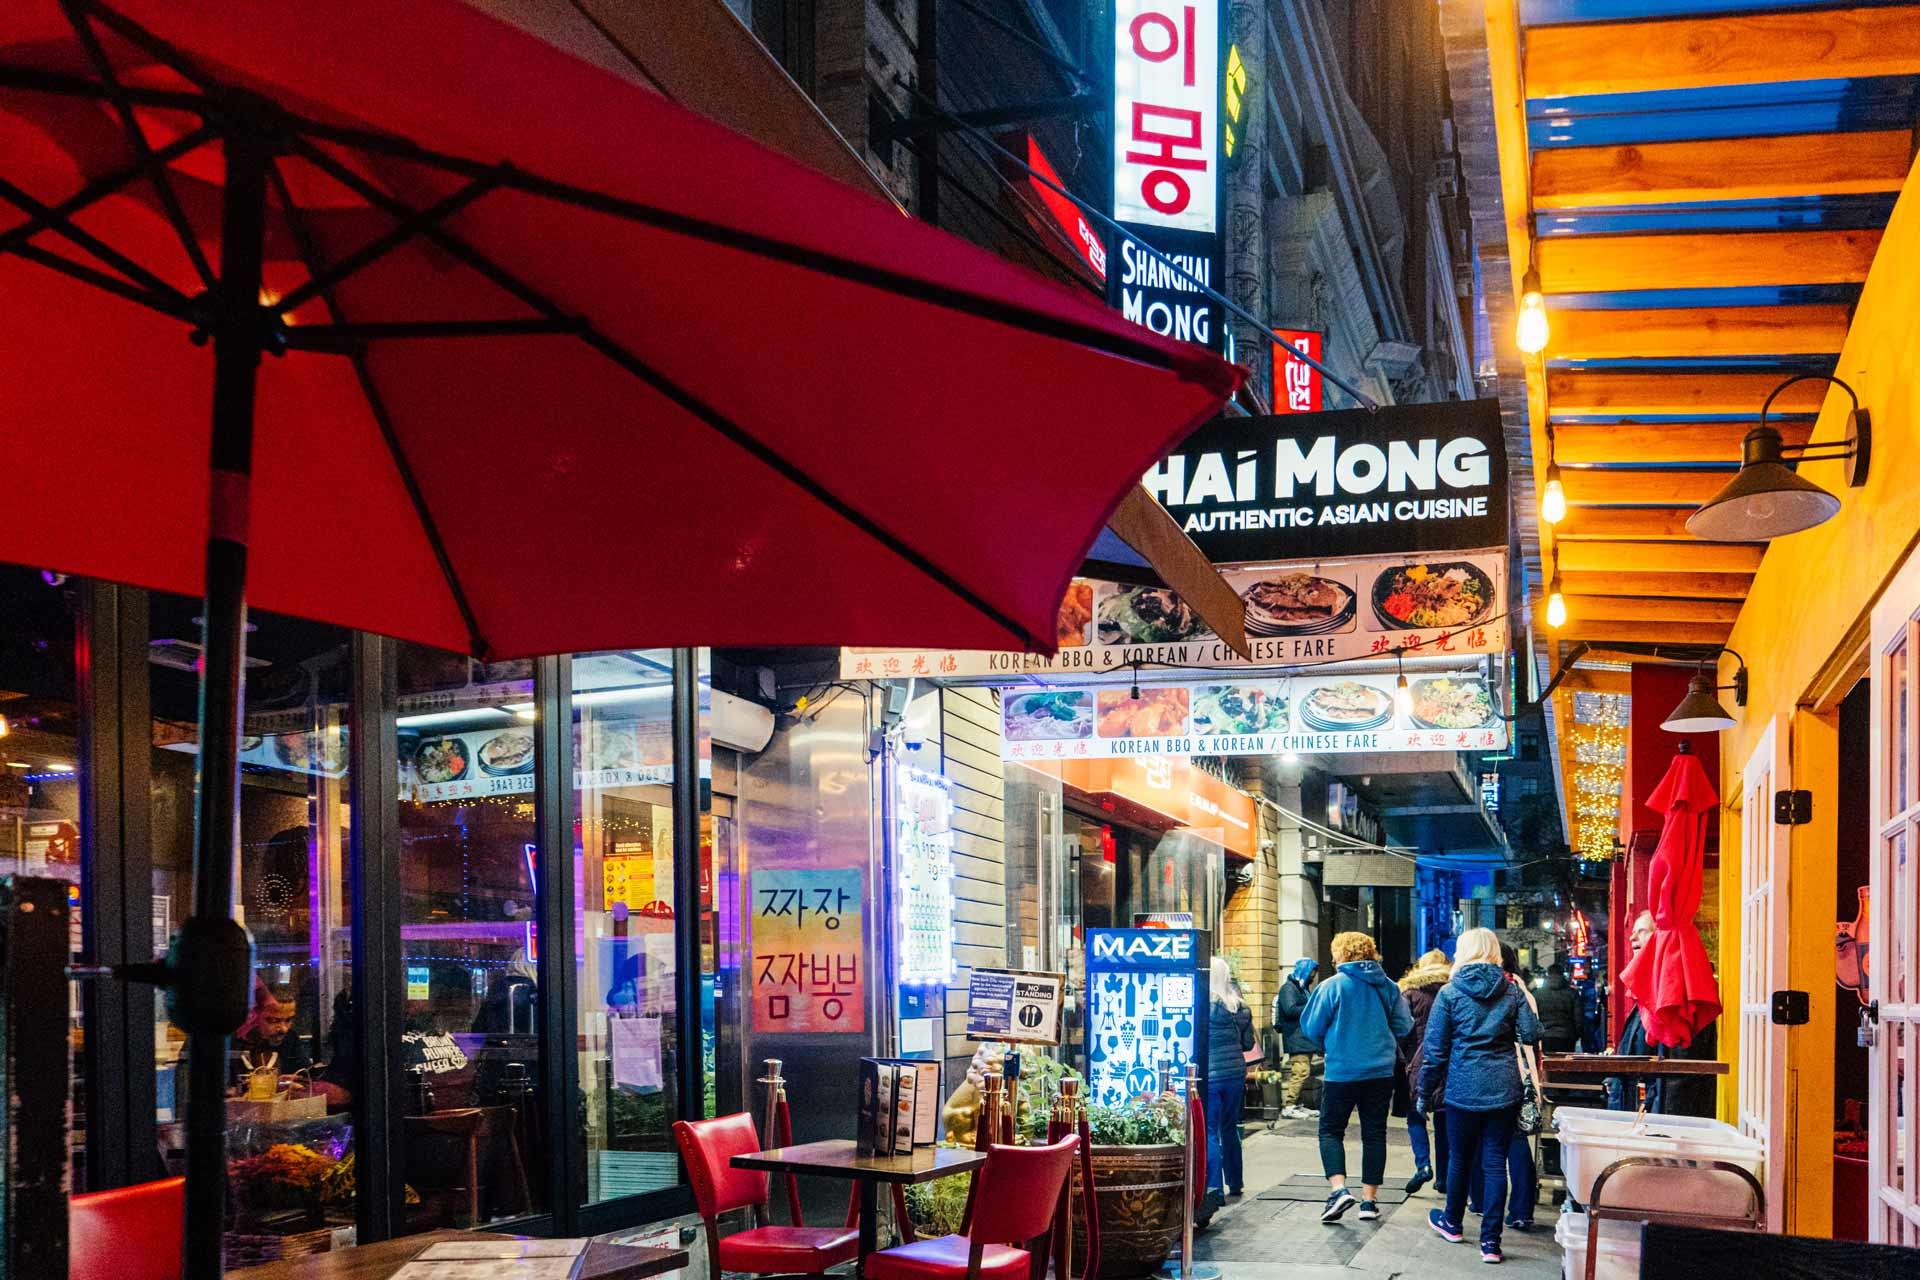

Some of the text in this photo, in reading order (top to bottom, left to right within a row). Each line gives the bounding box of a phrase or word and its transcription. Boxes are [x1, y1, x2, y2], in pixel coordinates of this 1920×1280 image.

[1126, 6, 1207, 215] 이몽
[1184, 497, 1487, 533] AUTHENTIC ASIAN CUISINE
[856, 654, 958, 675] 欢迎光临
[1062, 651, 1093, 668] BBQ
[1103, 650, 1113, 666] &
[1123, 645, 1188, 664] KOREAN
[1197, 646, 1204, 662] /
[1294, 638, 1336, 657] FARE
[1111, 740, 1160, 754] KOREAN
[1166, 738, 1191, 752] BBQ
[1198, 740, 1206, 752] &
[1213, 737, 1264, 751] KOREAN
[1283, 735, 1339, 750] CHINESE
[1346, 734, 1378, 749] FARE
[759, 888, 851, 931] 짜장
[1094, 934, 1190, 957] MAZE
[756, 952, 857, 1021] 짬뽕
[1015, 991, 1052, 999] STANDING
